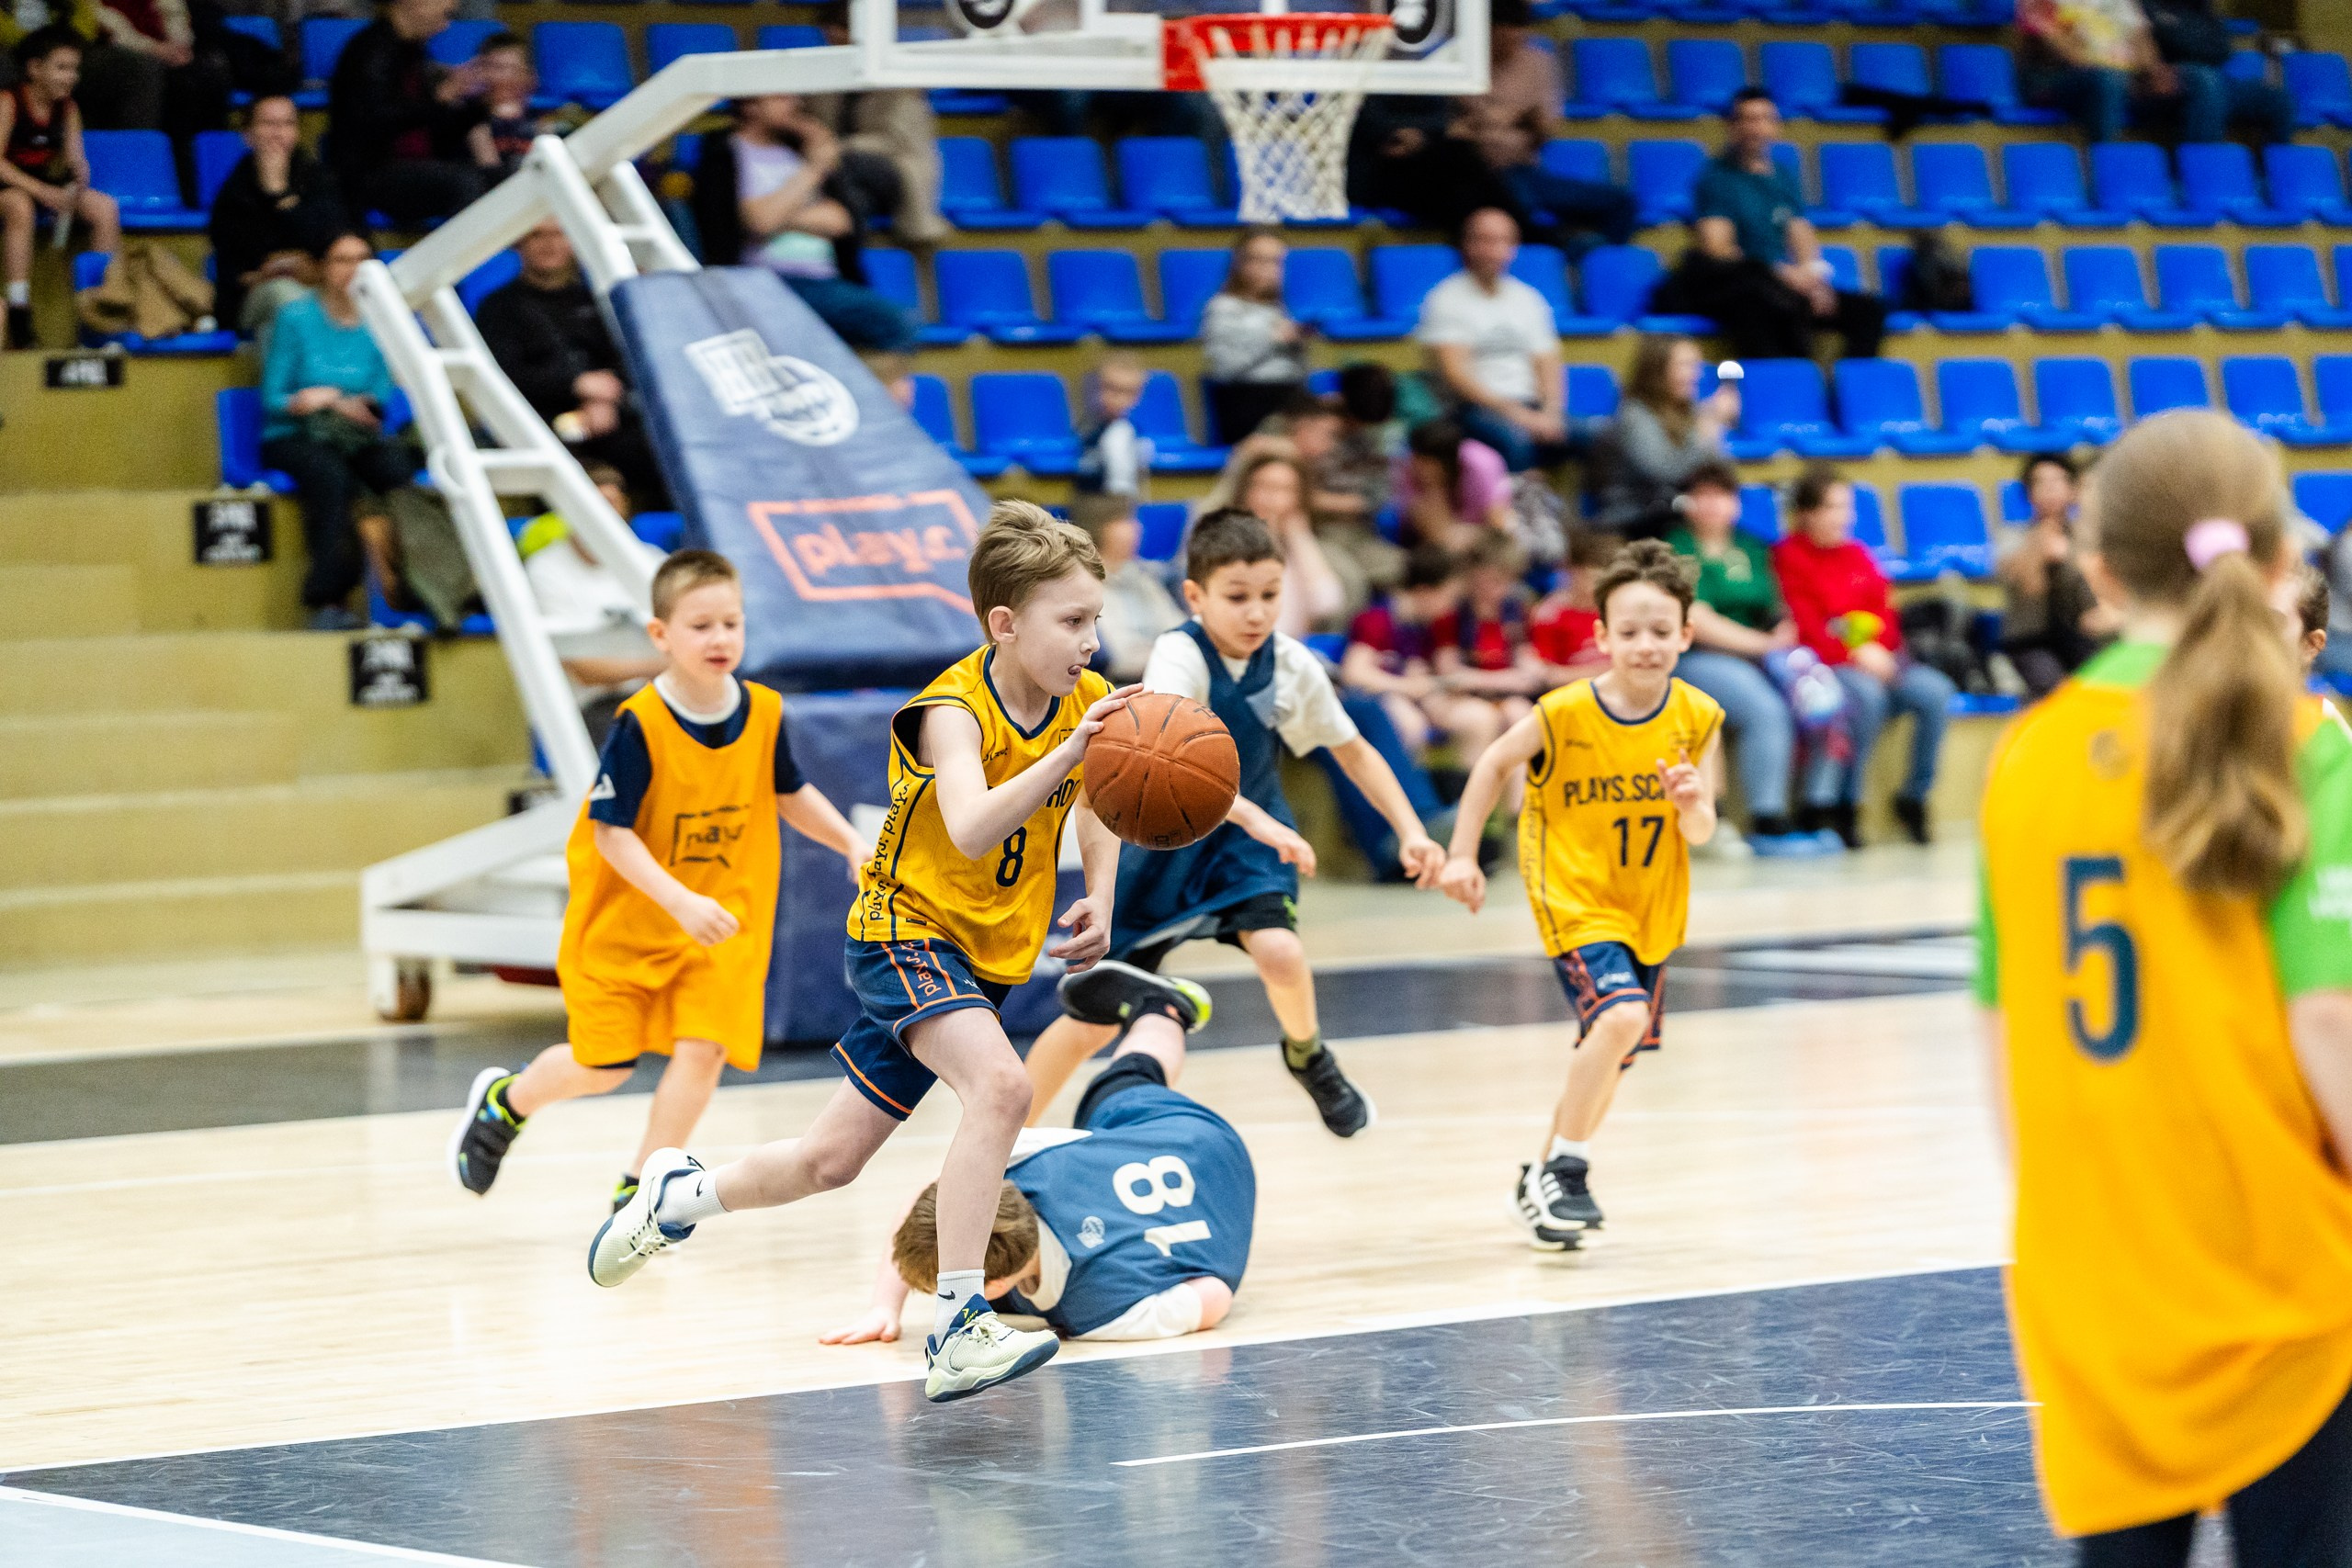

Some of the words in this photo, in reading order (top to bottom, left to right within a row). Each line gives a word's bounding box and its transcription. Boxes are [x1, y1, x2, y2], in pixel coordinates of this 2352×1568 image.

[1564, 773, 1666, 808] PLAYS.SC
[995, 825, 1027, 887] 8
[1612, 815, 1665, 867] 17
[2063, 854, 2140, 1062] 5
[1112, 1155, 1212, 1258] 18
